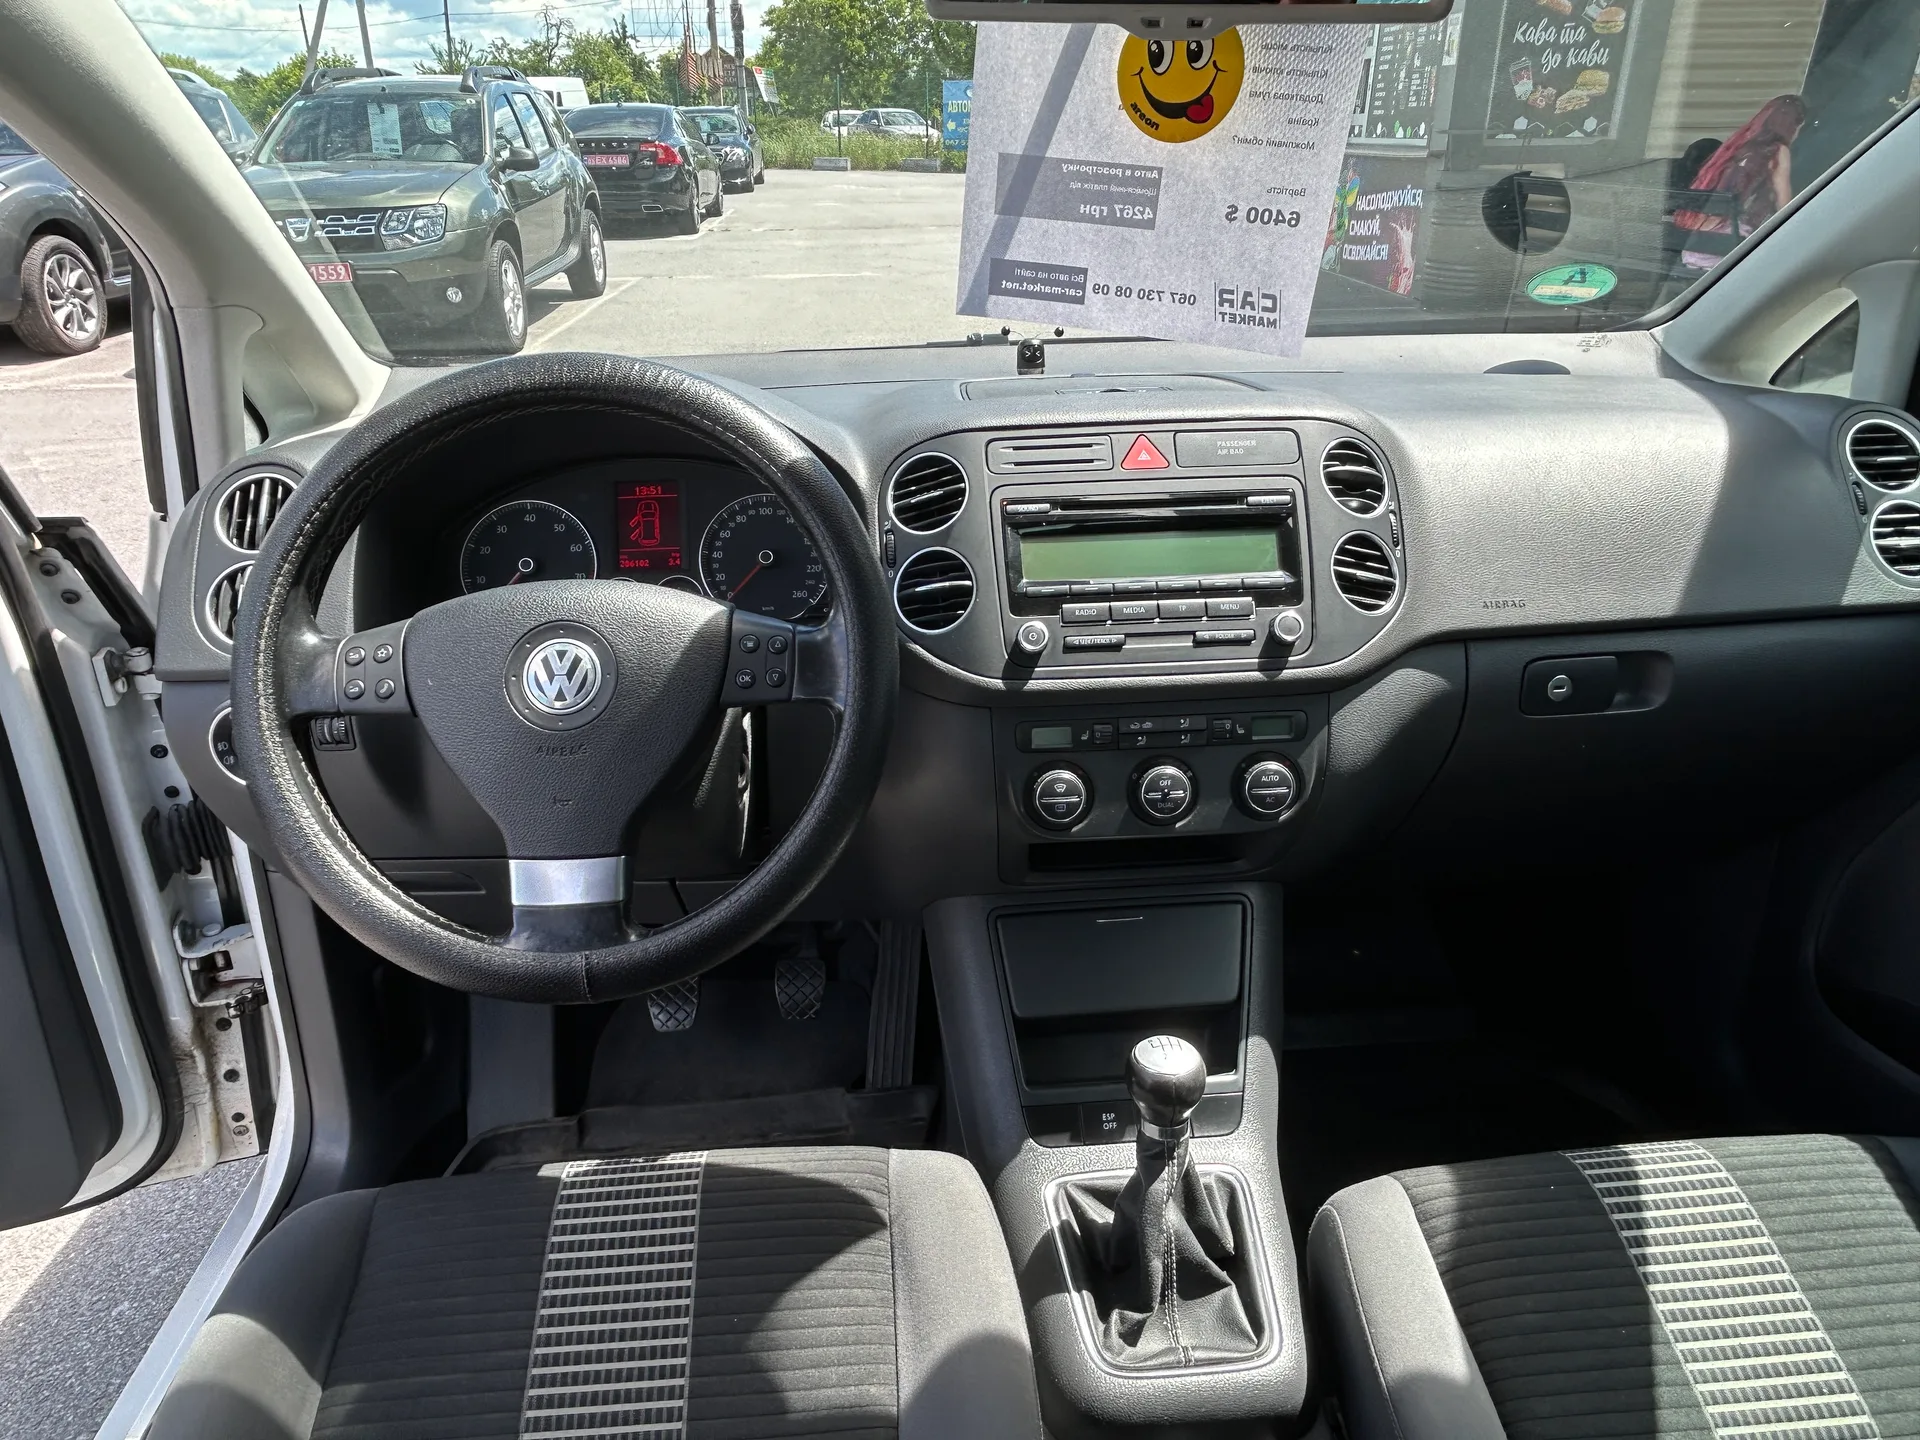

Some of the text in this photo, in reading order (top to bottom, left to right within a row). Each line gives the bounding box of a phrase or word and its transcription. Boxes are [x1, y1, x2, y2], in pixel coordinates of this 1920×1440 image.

[1513, 17, 1587, 46] Кава та
[1542, 39, 1609, 73] до кави
[1355, 184, 1424, 211] НАСОЛОДЖУЙСЯ,
[1349, 214, 1380, 236] СМАКУЙ,
[310, 265, 346, 281] 1559
[635, 485, 662, 496] 13:51
[759, 507, 773, 515] 100
[523, 513, 536, 522] 40
[735, 514, 747, 523] 80
[496, 525, 508, 534] 30
[553, 523, 566, 532] 50
[720, 530, 731, 538] 60
[479, 546, 491, 554] 20
[570, 543, 583, 552] 60
[712, 551, 723, 559] 40
[806, 564, 820, 573] 220
[475, 575, 486, 584] 10
[715, 573, 726, 581] 20
[792, 590, 808, 598] 260
[1123, 606, 1146, 615] MEDIA
[1220, 602, 1240, 610] MENU
[1075, 608, 1097, 616] RADIO
[739, 674, 752, 683] OK
[1159, 779, 1172, 787] OFF
[1261, 775, 1280, 783] AUTO
[1265, 796, 1276, 804] AC
[1102, 1112, 1116, 1121] ESP
[1102, 1121, 1118, 1130] OFF
